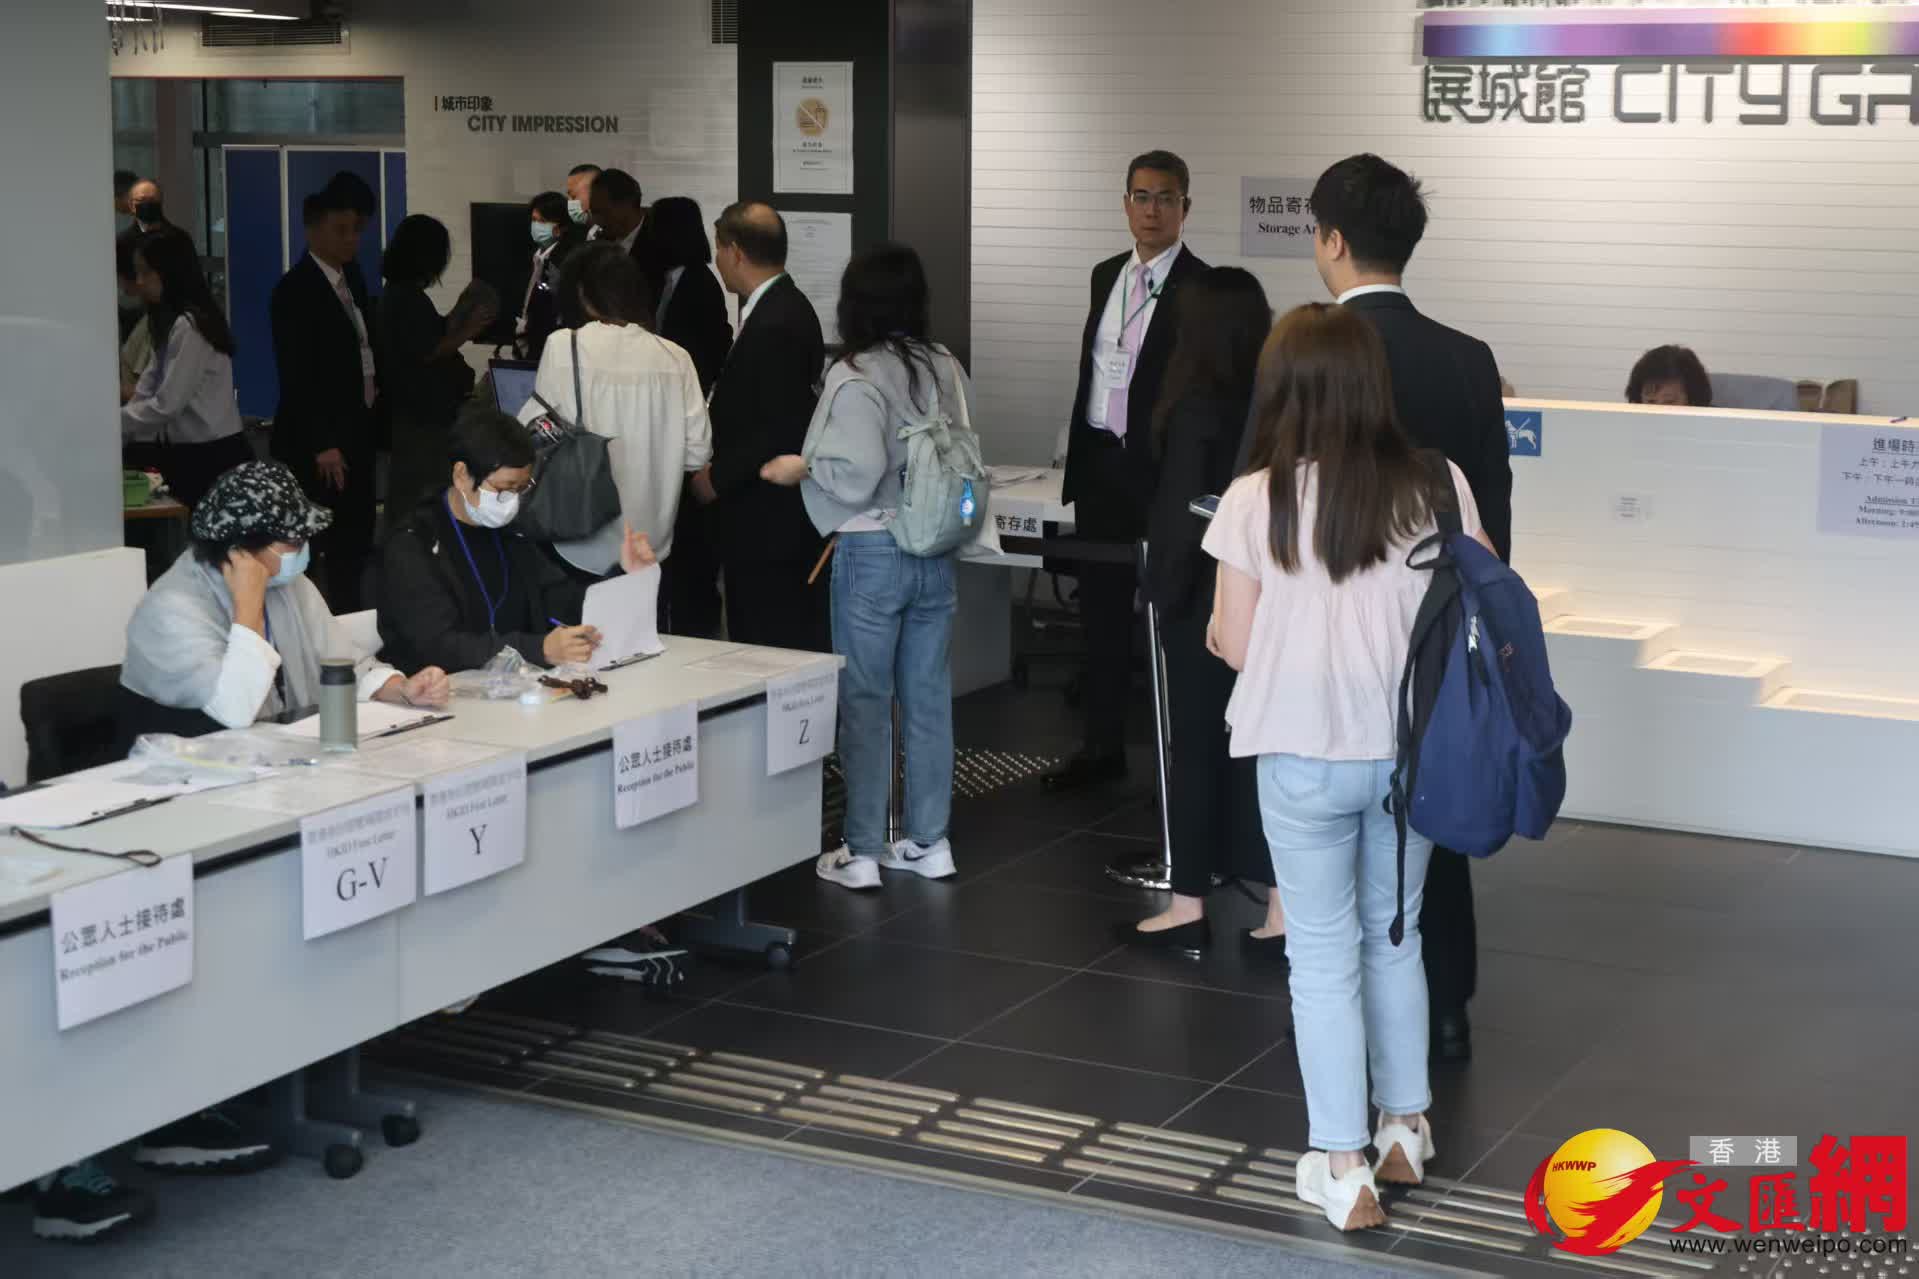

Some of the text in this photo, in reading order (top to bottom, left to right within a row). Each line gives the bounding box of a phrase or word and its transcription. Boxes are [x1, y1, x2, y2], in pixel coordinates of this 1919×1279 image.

[442, 95, 493, 112] 城市印象
[1423, 63, 1591, 124] 展城館
[1613, 63, 1790, 125] CITY
[467, 115, 619, 133] CITY IMPRESSION
[1258, 222, 1300, 237] Storage
[1872, 437, 1919, 453] 進場時
[799, 719, 810, 745] Z
[469, 823, 488, 855] Y
[336, 856, 390, 902] G-V
[61, 897, 185, 955] 公眾人士接待處
